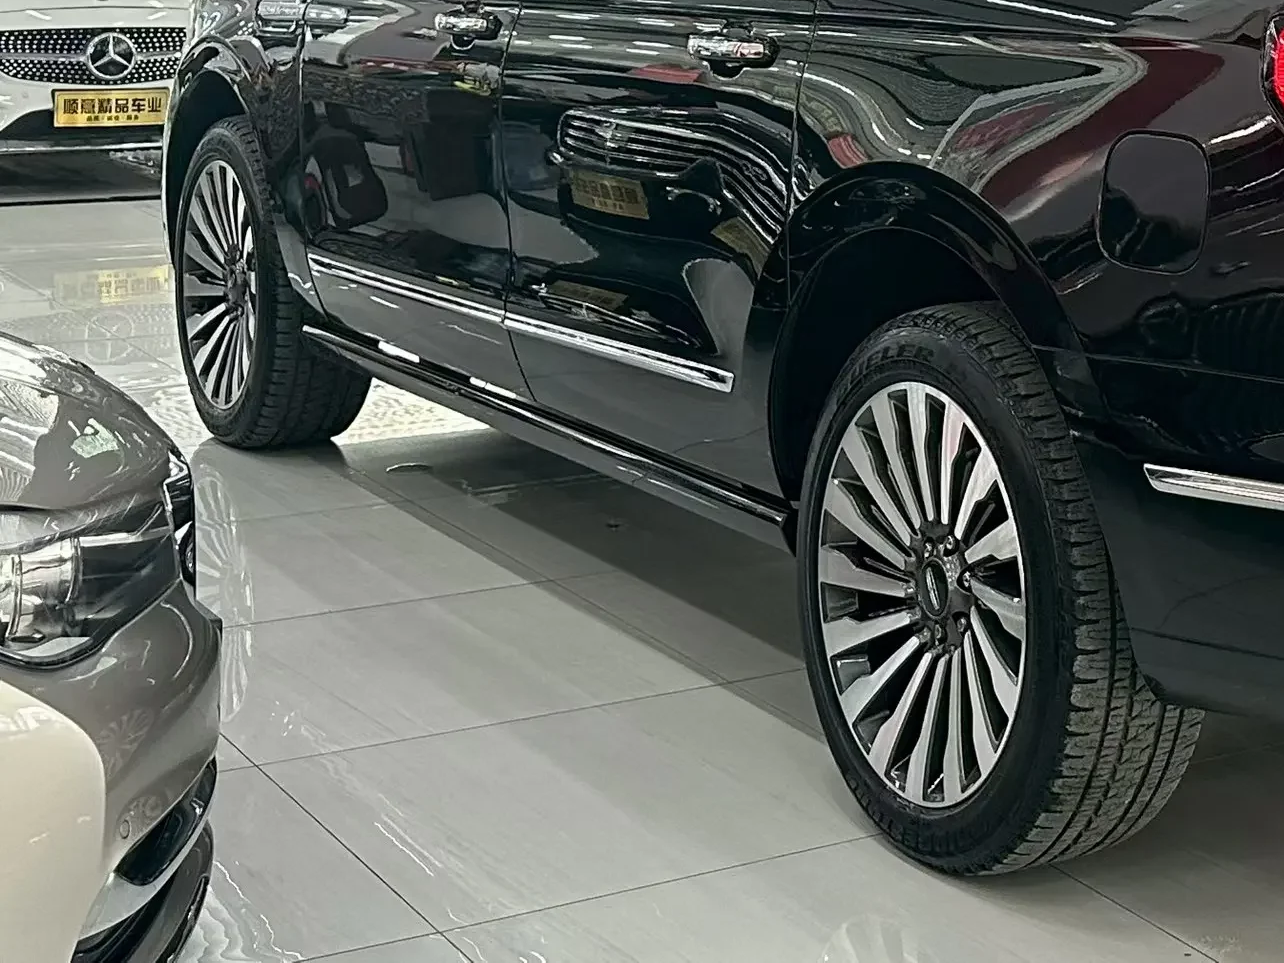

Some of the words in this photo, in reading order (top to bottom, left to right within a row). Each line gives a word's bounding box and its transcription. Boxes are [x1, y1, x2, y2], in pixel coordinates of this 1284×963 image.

[63, 96, 162, 115] 顺意精品车业
